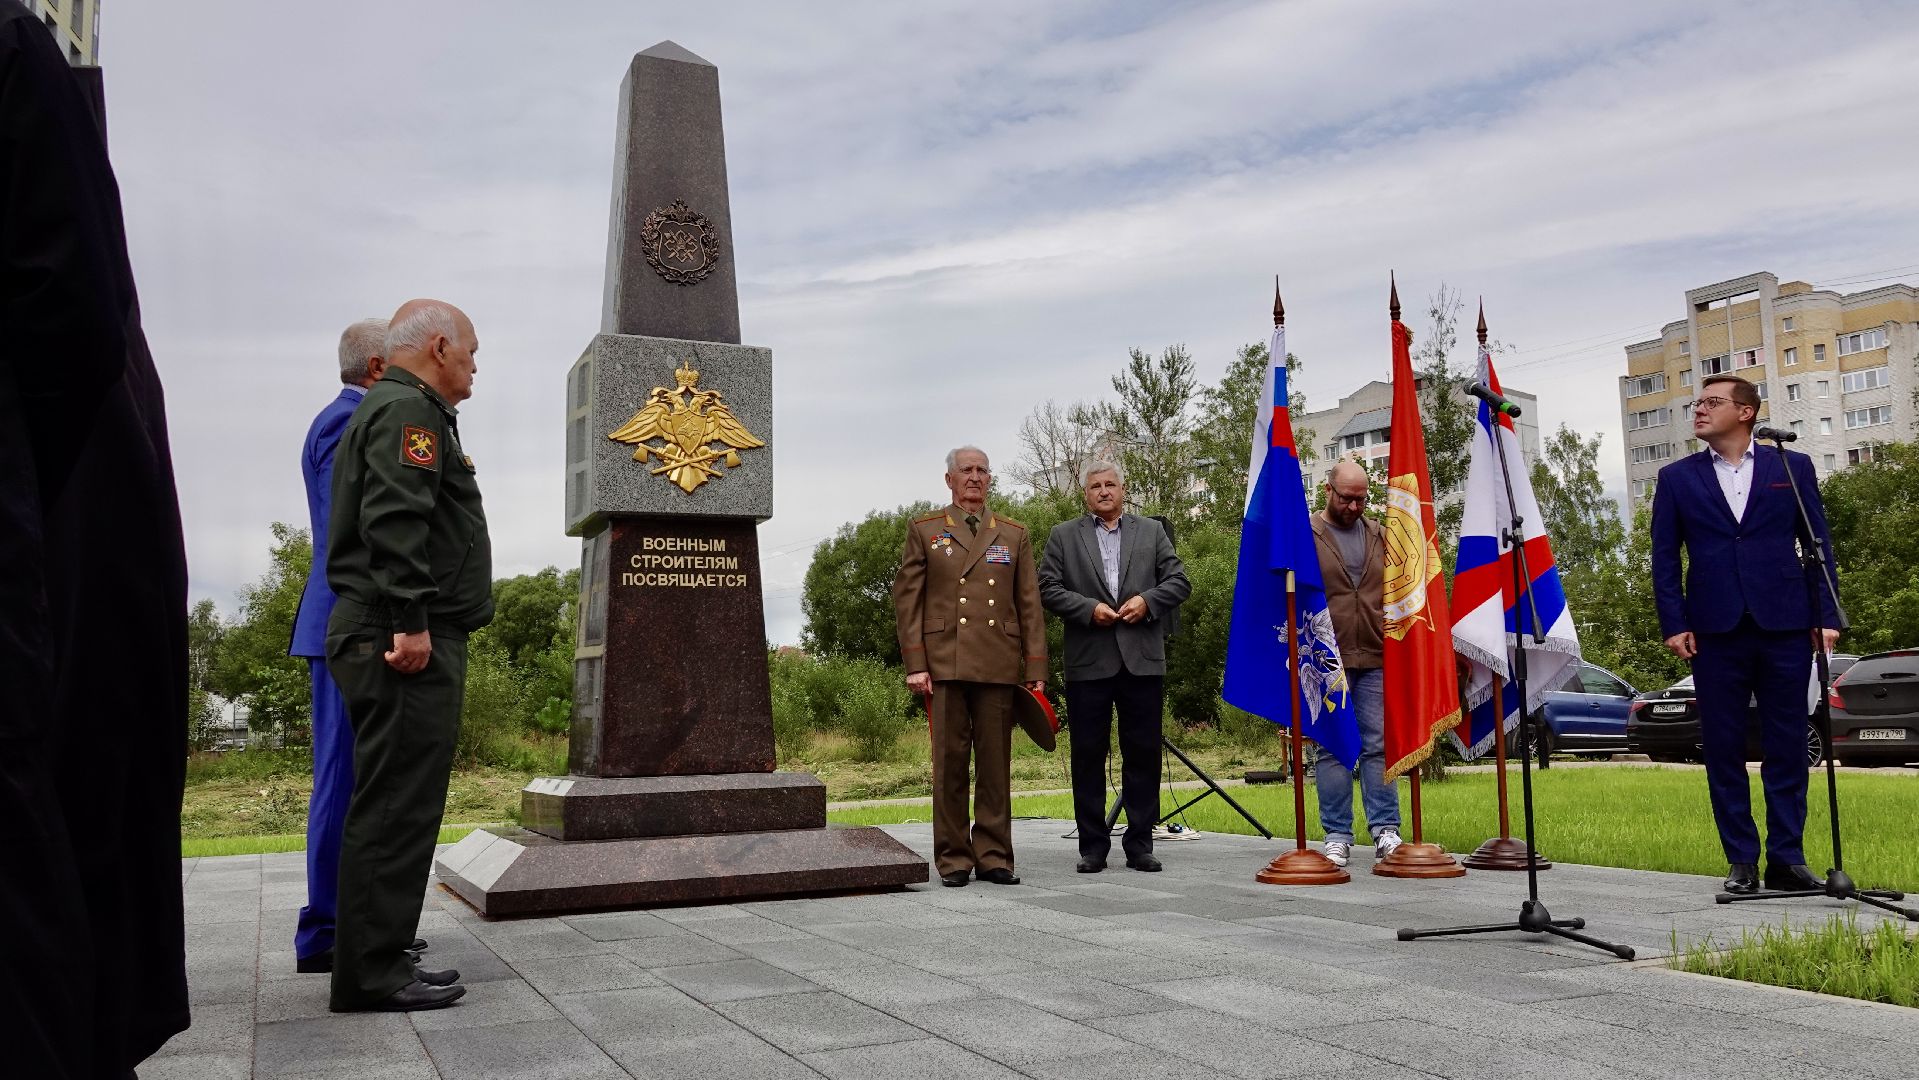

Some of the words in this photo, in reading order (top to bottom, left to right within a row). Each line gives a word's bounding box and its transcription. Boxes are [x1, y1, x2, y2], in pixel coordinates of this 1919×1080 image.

[643, 537, 726, 552] ВОЕННЫМ
[630, 554, 738, 570] СТРОИТЕЛЯМ
[622, 572, 747, 589] ПОСВЯЩАЕТСЯ
